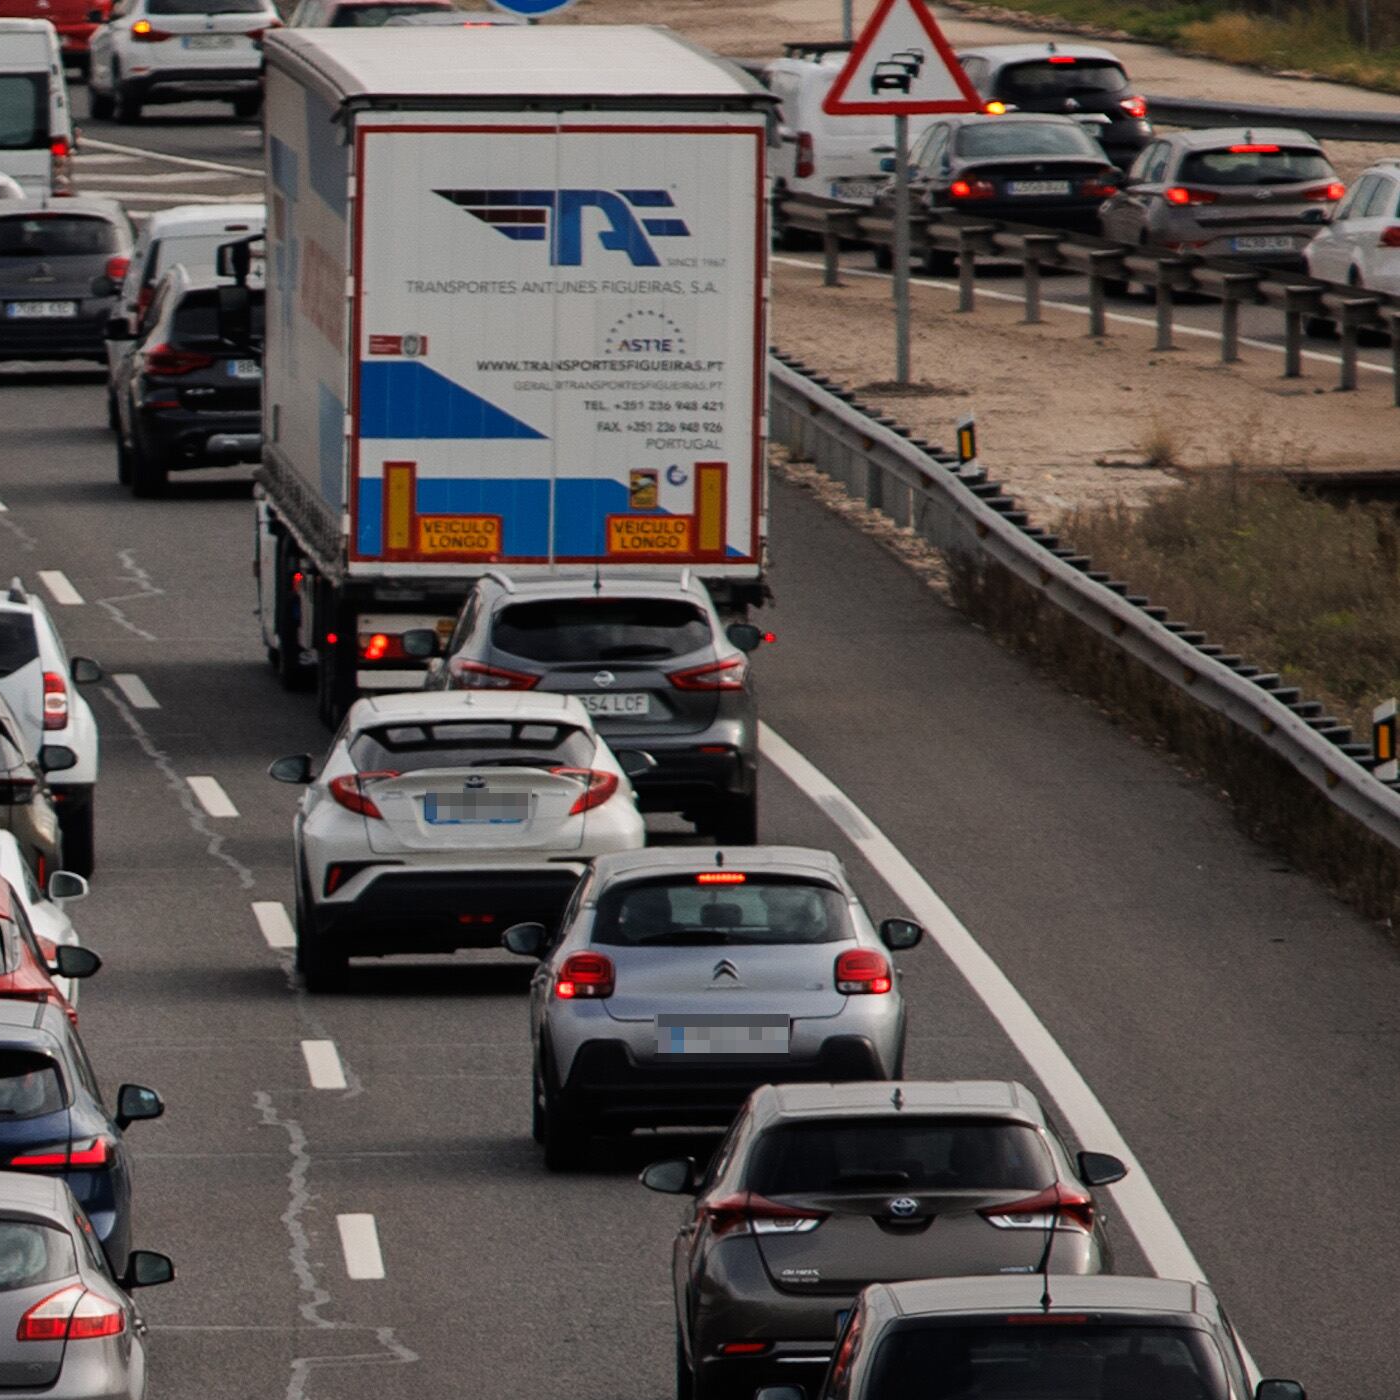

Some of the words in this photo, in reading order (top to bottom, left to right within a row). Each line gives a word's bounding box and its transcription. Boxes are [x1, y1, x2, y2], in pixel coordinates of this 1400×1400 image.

[667, 257, 698, 268] SINCE
[406, 279, 517, 294] TRANSPORTES
[521, 279, 598, 294] ANTUNES
[602, 279, 686, 295] FIGUEIRAS,
[618, 339, 673, 352] ASTRE
[476, 360, 724, 372] WWW.TRANSPORTESFIGUEIRAS.PT
[646, 438, 722, 450] PORTUGAL
[429, 535, 489, 548] LONGO
[620, 535, 680, 549] LONGO
